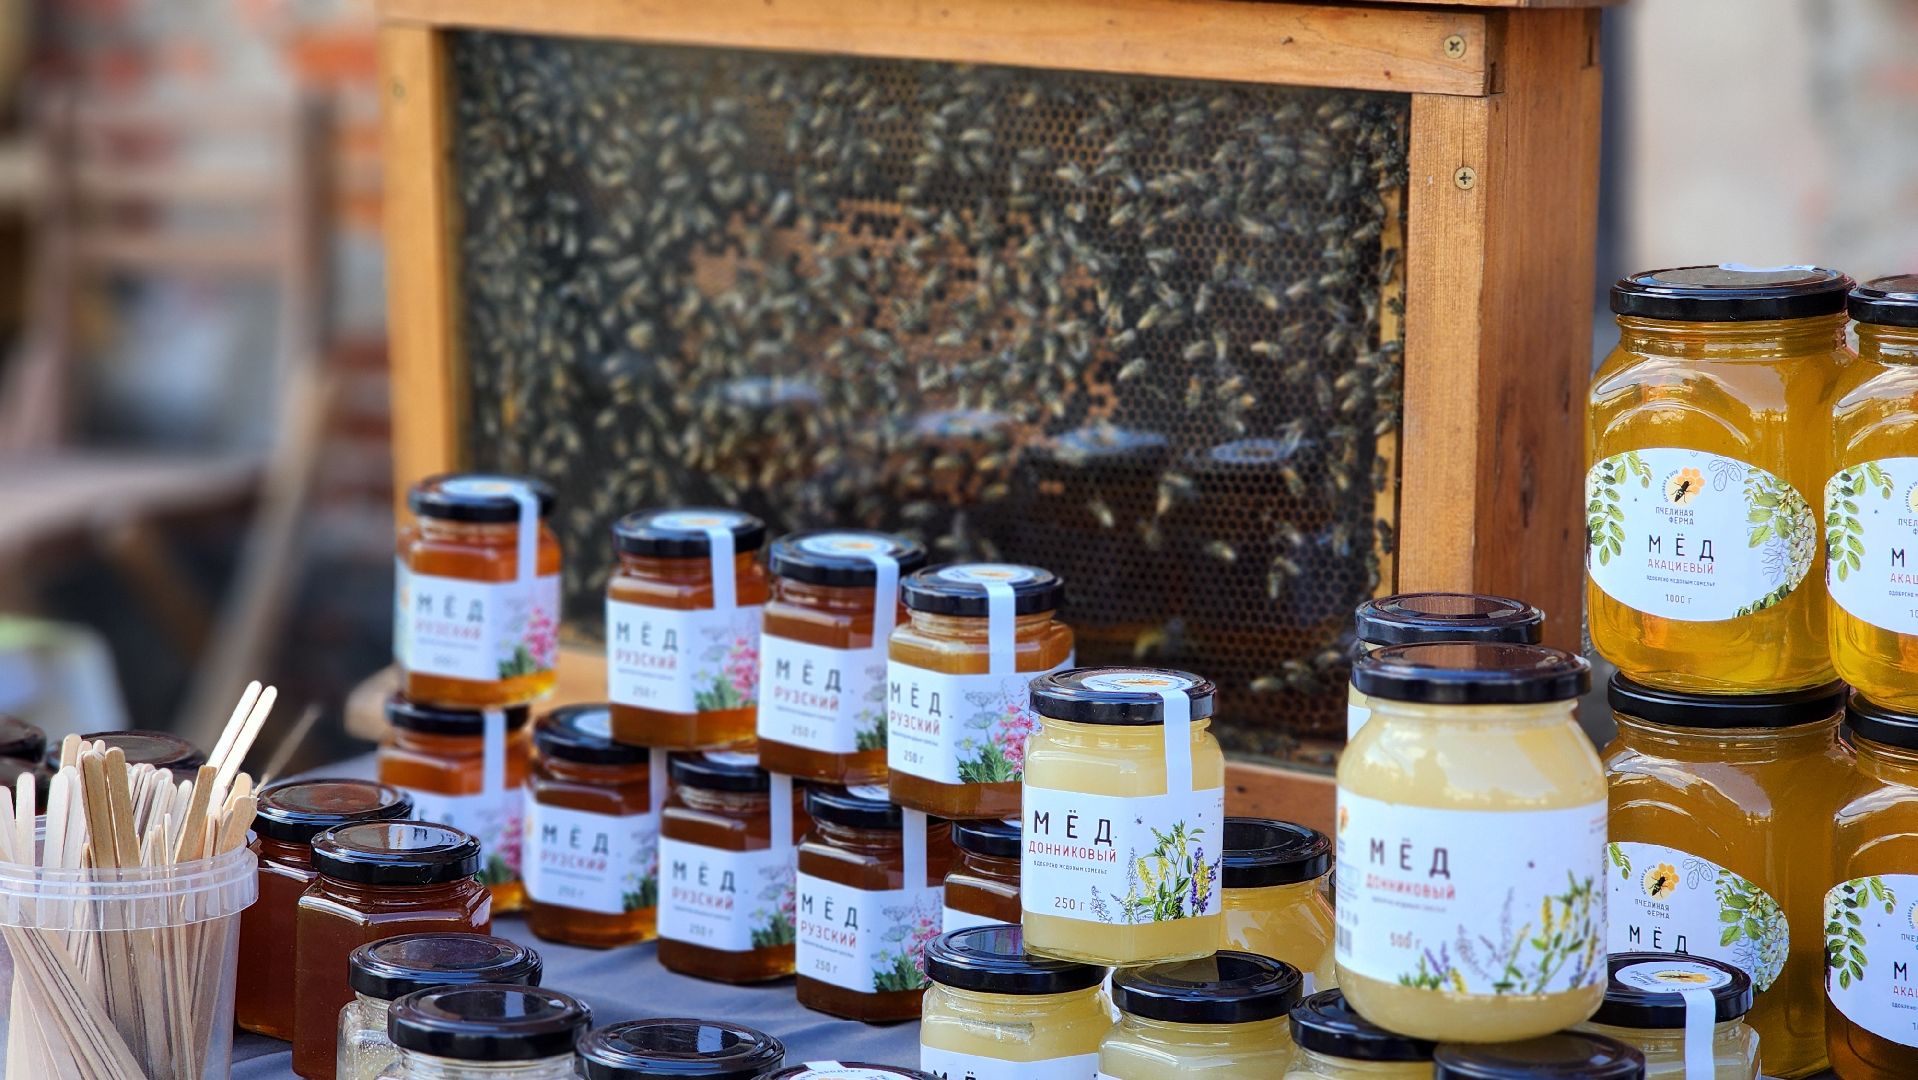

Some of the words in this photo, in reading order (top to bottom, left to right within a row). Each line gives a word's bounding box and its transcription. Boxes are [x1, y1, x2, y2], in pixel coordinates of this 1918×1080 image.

[1655, 506, 1694, 517] ПЧЕЛИНАЯ
[1668, 516, 1694, 525] ФЕРМА
[1648, 532, 1714, 563] МЁД
[1647, 558, 1714, 575] АКАЦИЕВЫЙ
[615, 621, 679, 653] МЁД
[775, 657, 841, 693] МЁД
[890, 681, 942, 718] МЁД
[890, 709, 941, 737] РУЗСКИЙ
[542, 823, 609, 856] МЁД
[1033, 808, 1113, 847] МЁД
[1028, 840, 1117, 863] ДОННИКОВЫЙ
[1370, 838, 1451, 880] МЁД
[673, 860, 737, 894] МЁД
[1365, 873, 1456, 901] ДОННИКОВЫЙ
[801, 893, 858, 931] МЁД
[1054, 896, 1076, 910] 250
[1634, 898, 1670, 912] ПЧЕЛИНАЯ
[1647, 909, 1670, 919] ФЕРМА
[800, 920, 857, 949] РУЗСКИЙ
[1629, 924, 1688, 954] МЁД
[815, 958, 831, 973] 250
